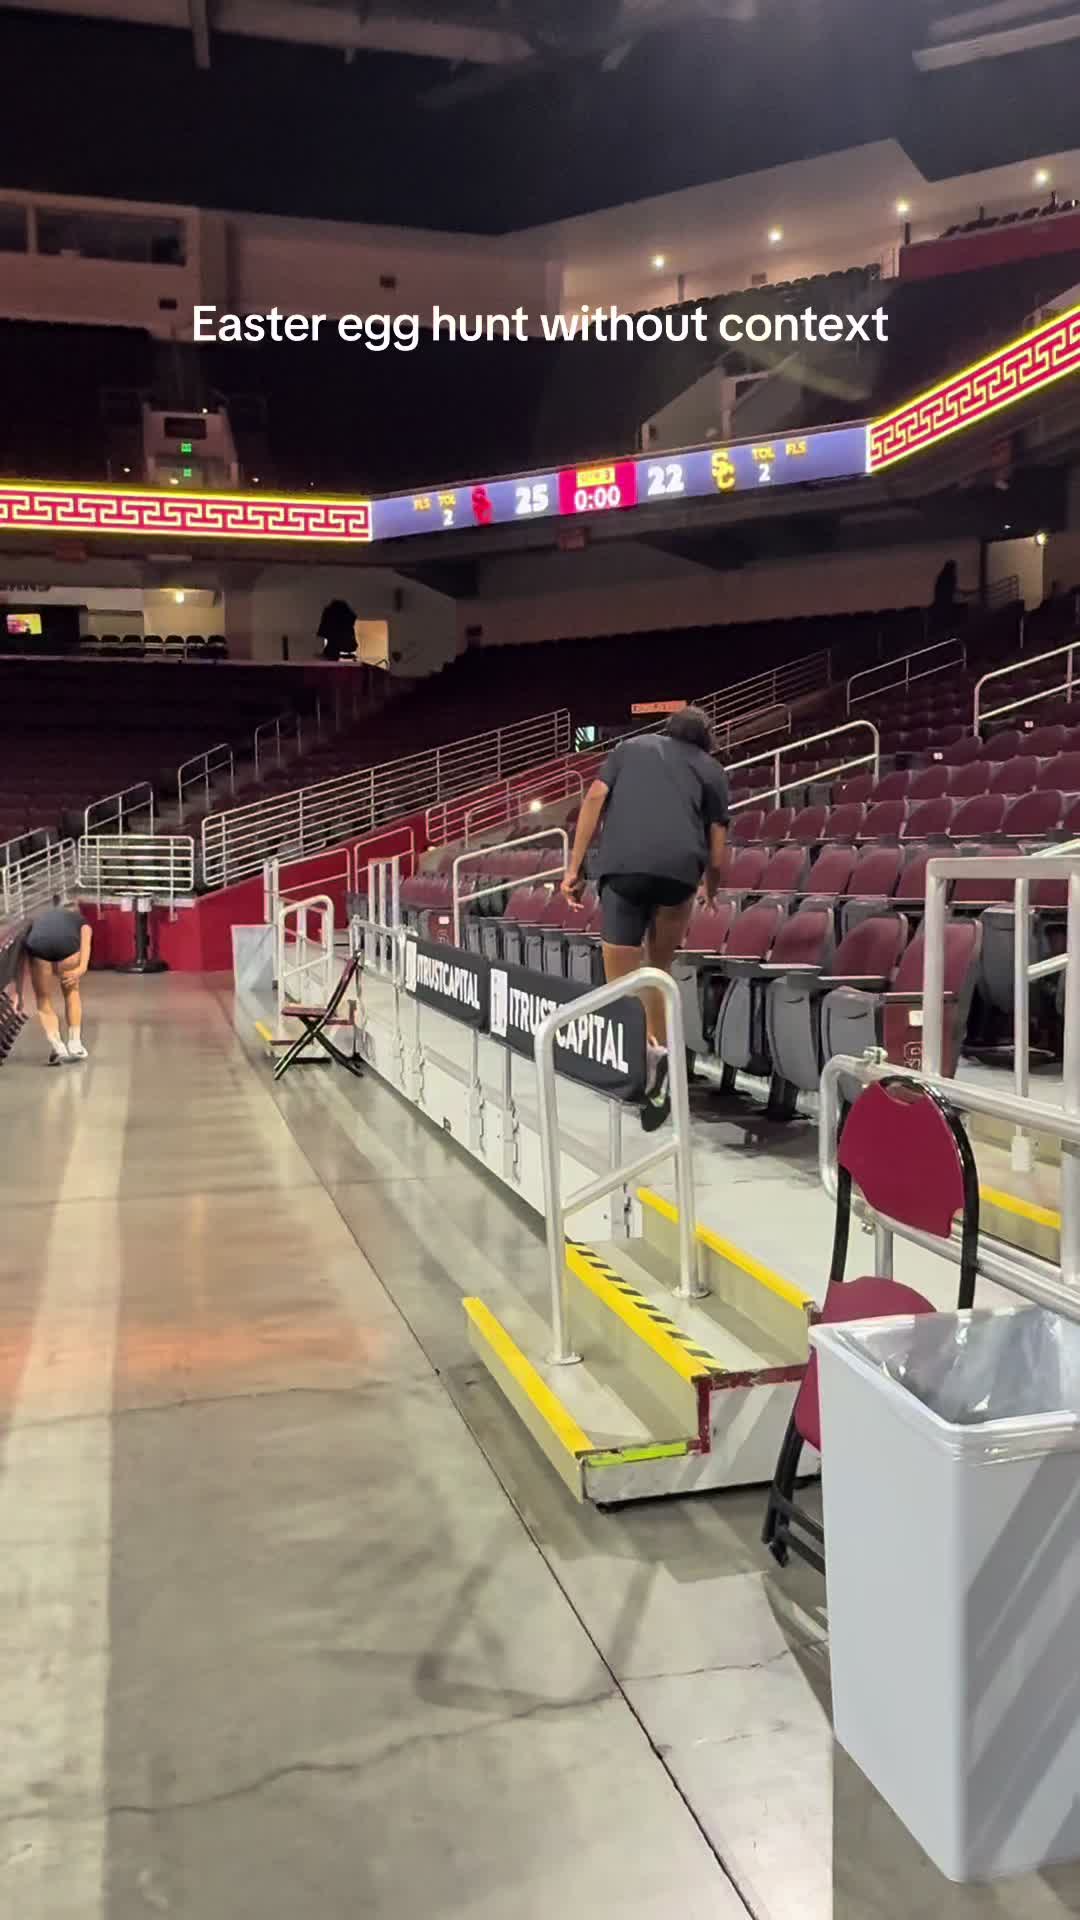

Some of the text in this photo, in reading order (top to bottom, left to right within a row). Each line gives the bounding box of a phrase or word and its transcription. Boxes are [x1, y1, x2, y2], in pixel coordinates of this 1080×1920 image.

[647, 463, 685, 496] 22
[758, 463, 771, 482] 2
[515, 483, 549, 515] 25
[574, 485, 621, 511] 0:00
[443, 510, 454, 526] 2
[417, 953, 481, 1010] ITRUSTCAPITAL
